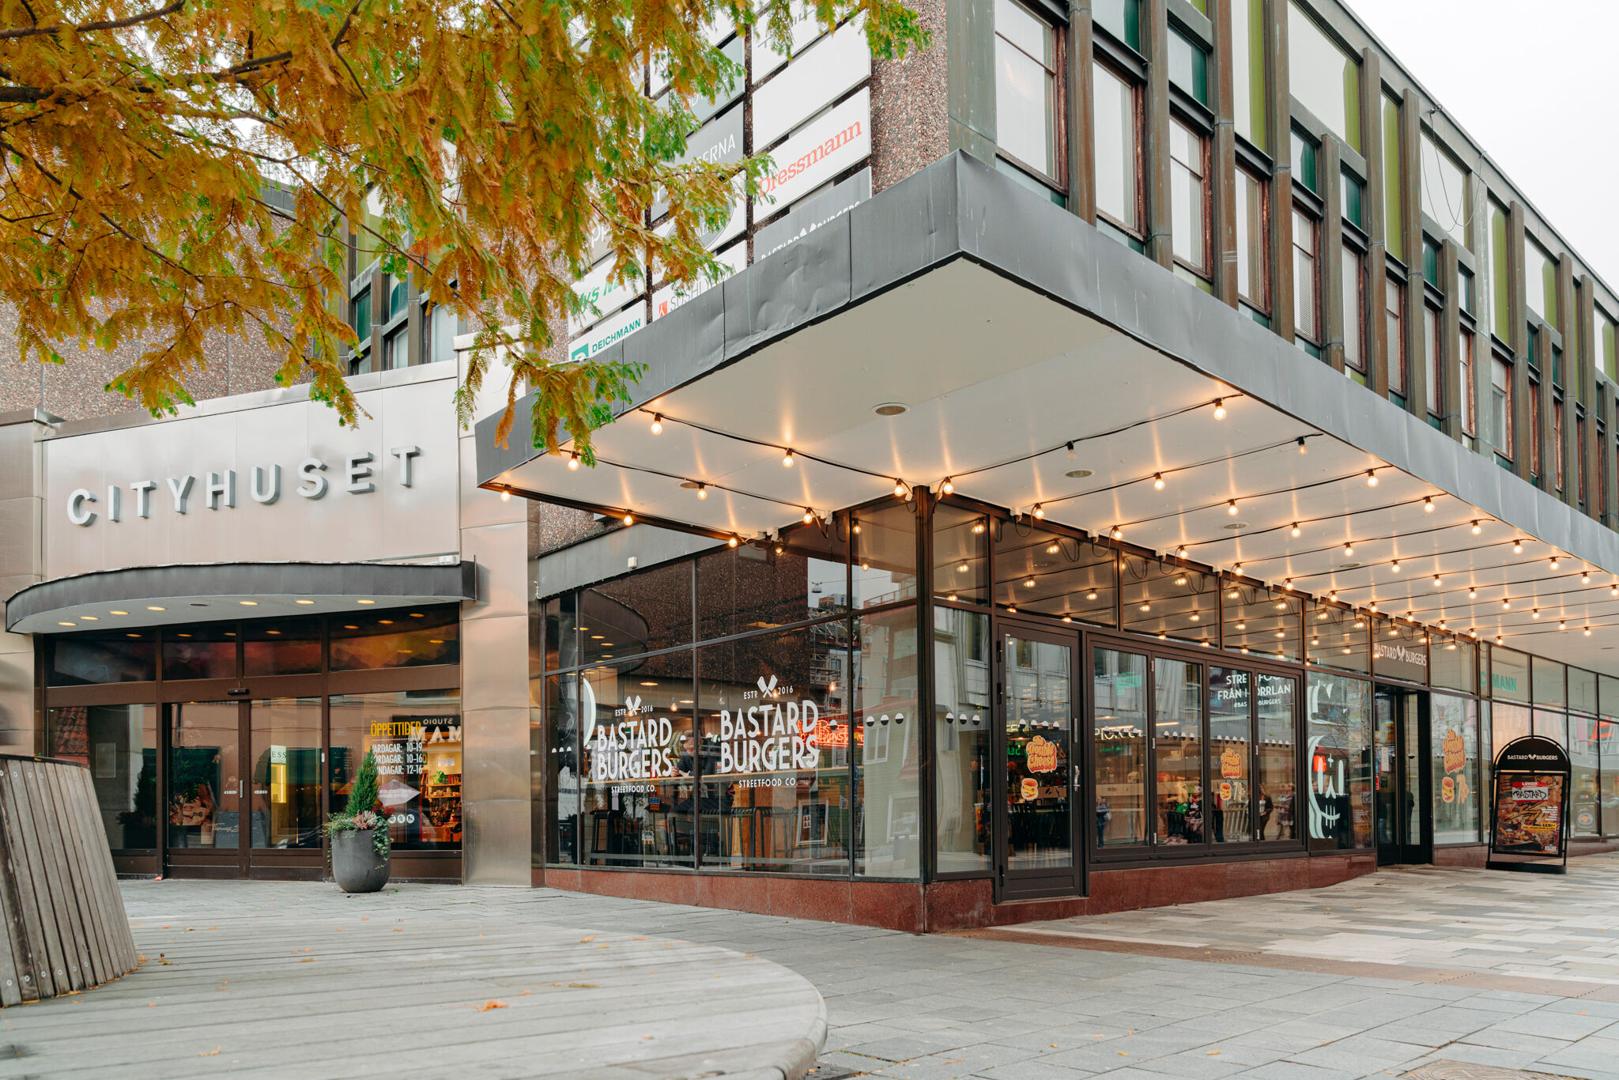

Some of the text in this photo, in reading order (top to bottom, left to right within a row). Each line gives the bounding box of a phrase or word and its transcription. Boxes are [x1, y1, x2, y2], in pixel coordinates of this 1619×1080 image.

[592, 318, 641, 353] DEICHMANN
[67, 445, 421, 527] CITYHUSET
[1405, 651, 1427, 666] BURGERS
[777, 685, 794, 695] 2016
[640, 705, 654, 714] 2016
[720, 700, 819, 741] BASTARD
[597, 717, 673, 752] BASTARD
[597, 747, 673, 780] BURGERS
[720, 735, 820, 773] BURGERS
[611, 785, 645, 794] STREETFOOD
[738, 778, 782, 788] STREETFOOD
